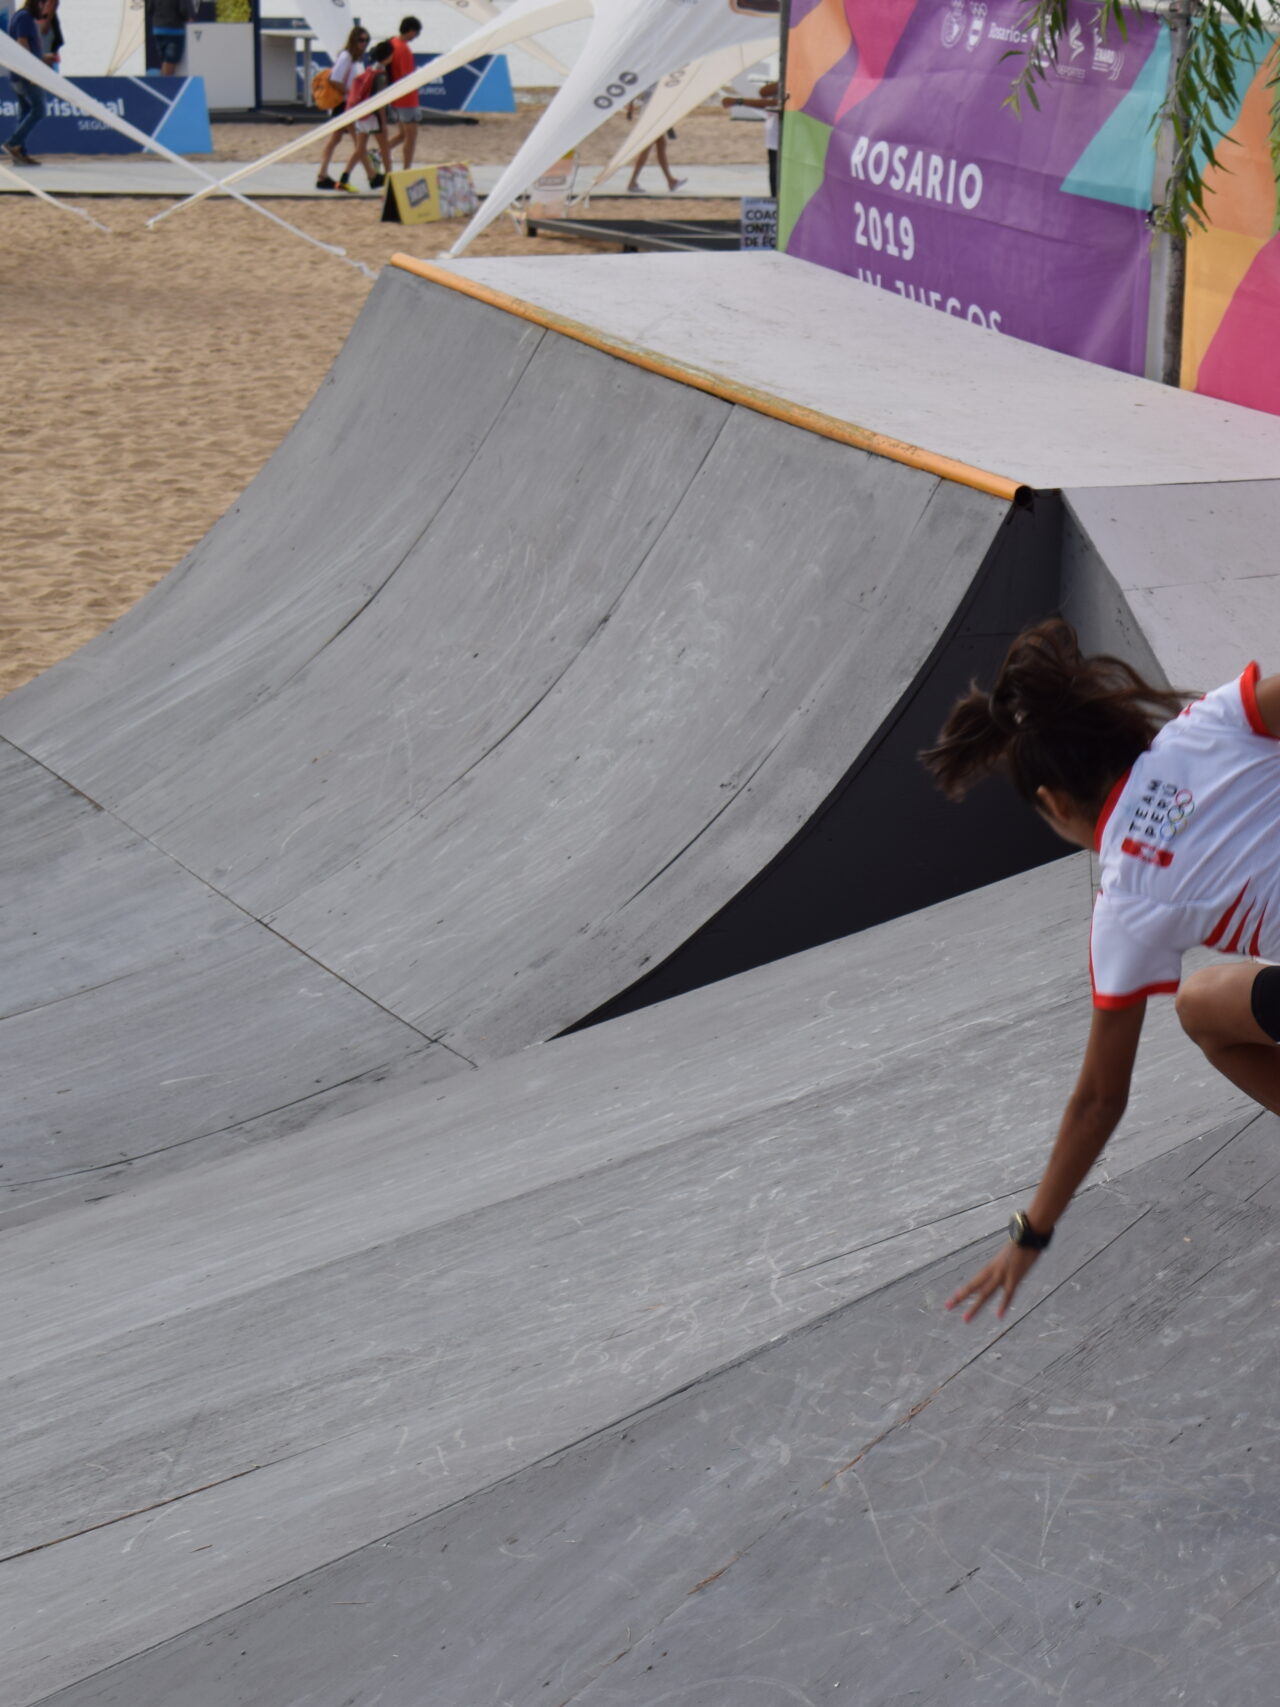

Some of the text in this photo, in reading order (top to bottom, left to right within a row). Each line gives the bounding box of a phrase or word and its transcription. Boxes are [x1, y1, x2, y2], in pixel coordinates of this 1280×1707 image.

[851, 136, 983, 210] ROSARIO
[854, 201, 916, 261] 2019
[1128, 780, 1160, 832] TEAM
